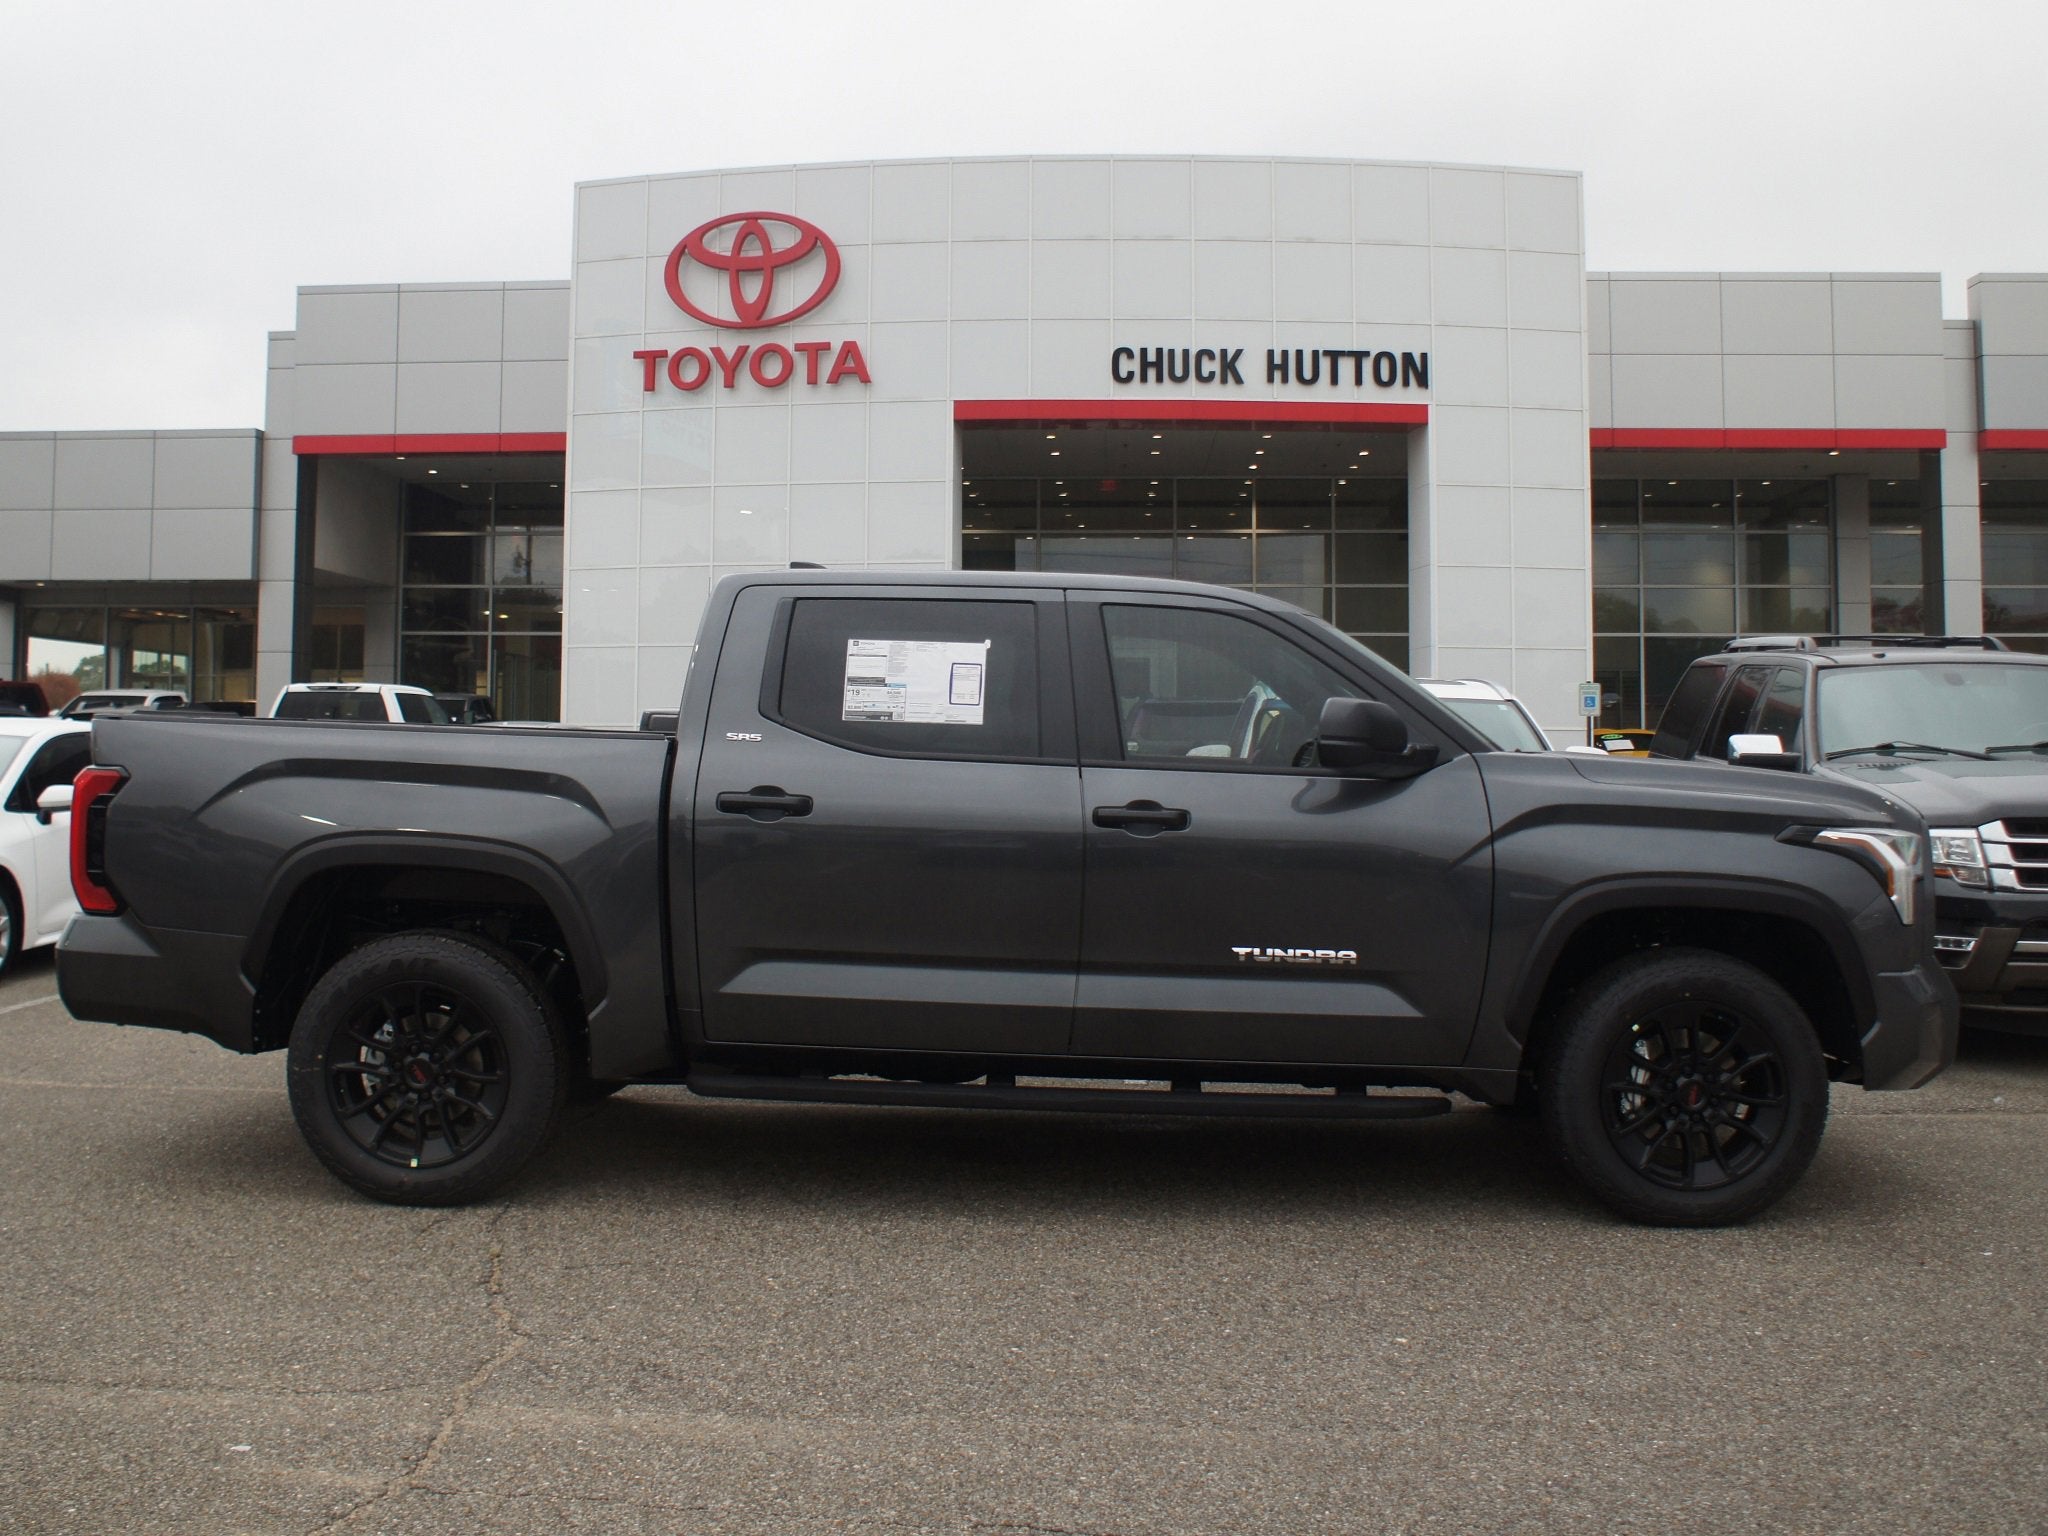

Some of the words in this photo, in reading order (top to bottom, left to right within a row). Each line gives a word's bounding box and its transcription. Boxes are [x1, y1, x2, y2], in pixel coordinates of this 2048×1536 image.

[633, 340, 872, 392] TOYOTA
[1111, 347, 1245, 385] CHUCK
[1266, 349, 1429, 389] HUTTON
[1231, 947, 1357, 964] TUNDRA
